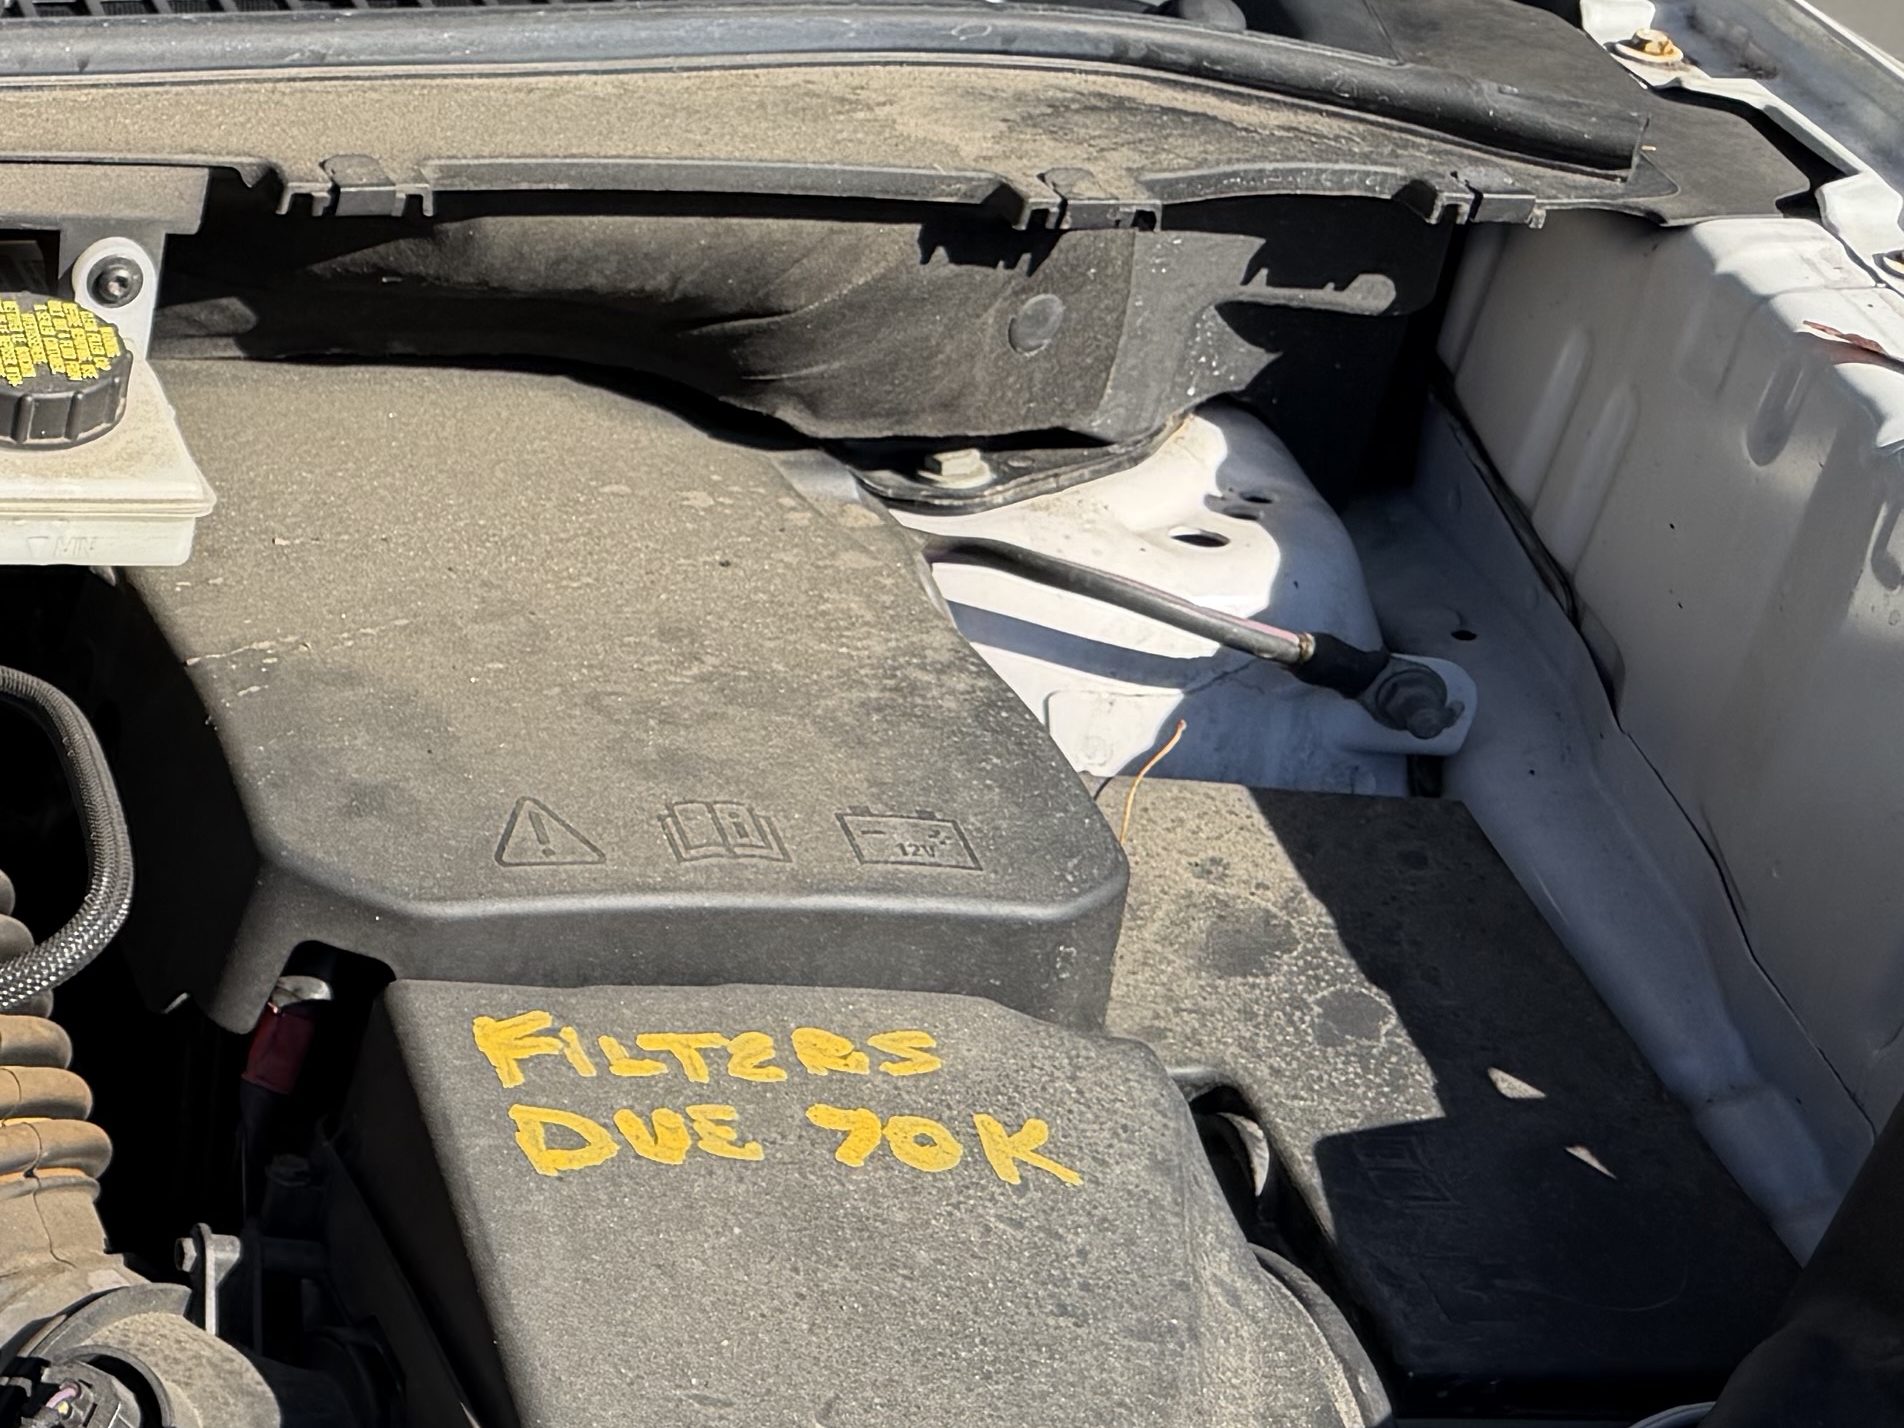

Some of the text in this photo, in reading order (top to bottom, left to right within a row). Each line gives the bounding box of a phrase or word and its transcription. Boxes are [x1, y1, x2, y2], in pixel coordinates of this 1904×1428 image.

[895, 842, 936, 858] 12V
[473, 1010, 943, 1087] FILTERS
[508, 1103, 765, 1176] DUE
